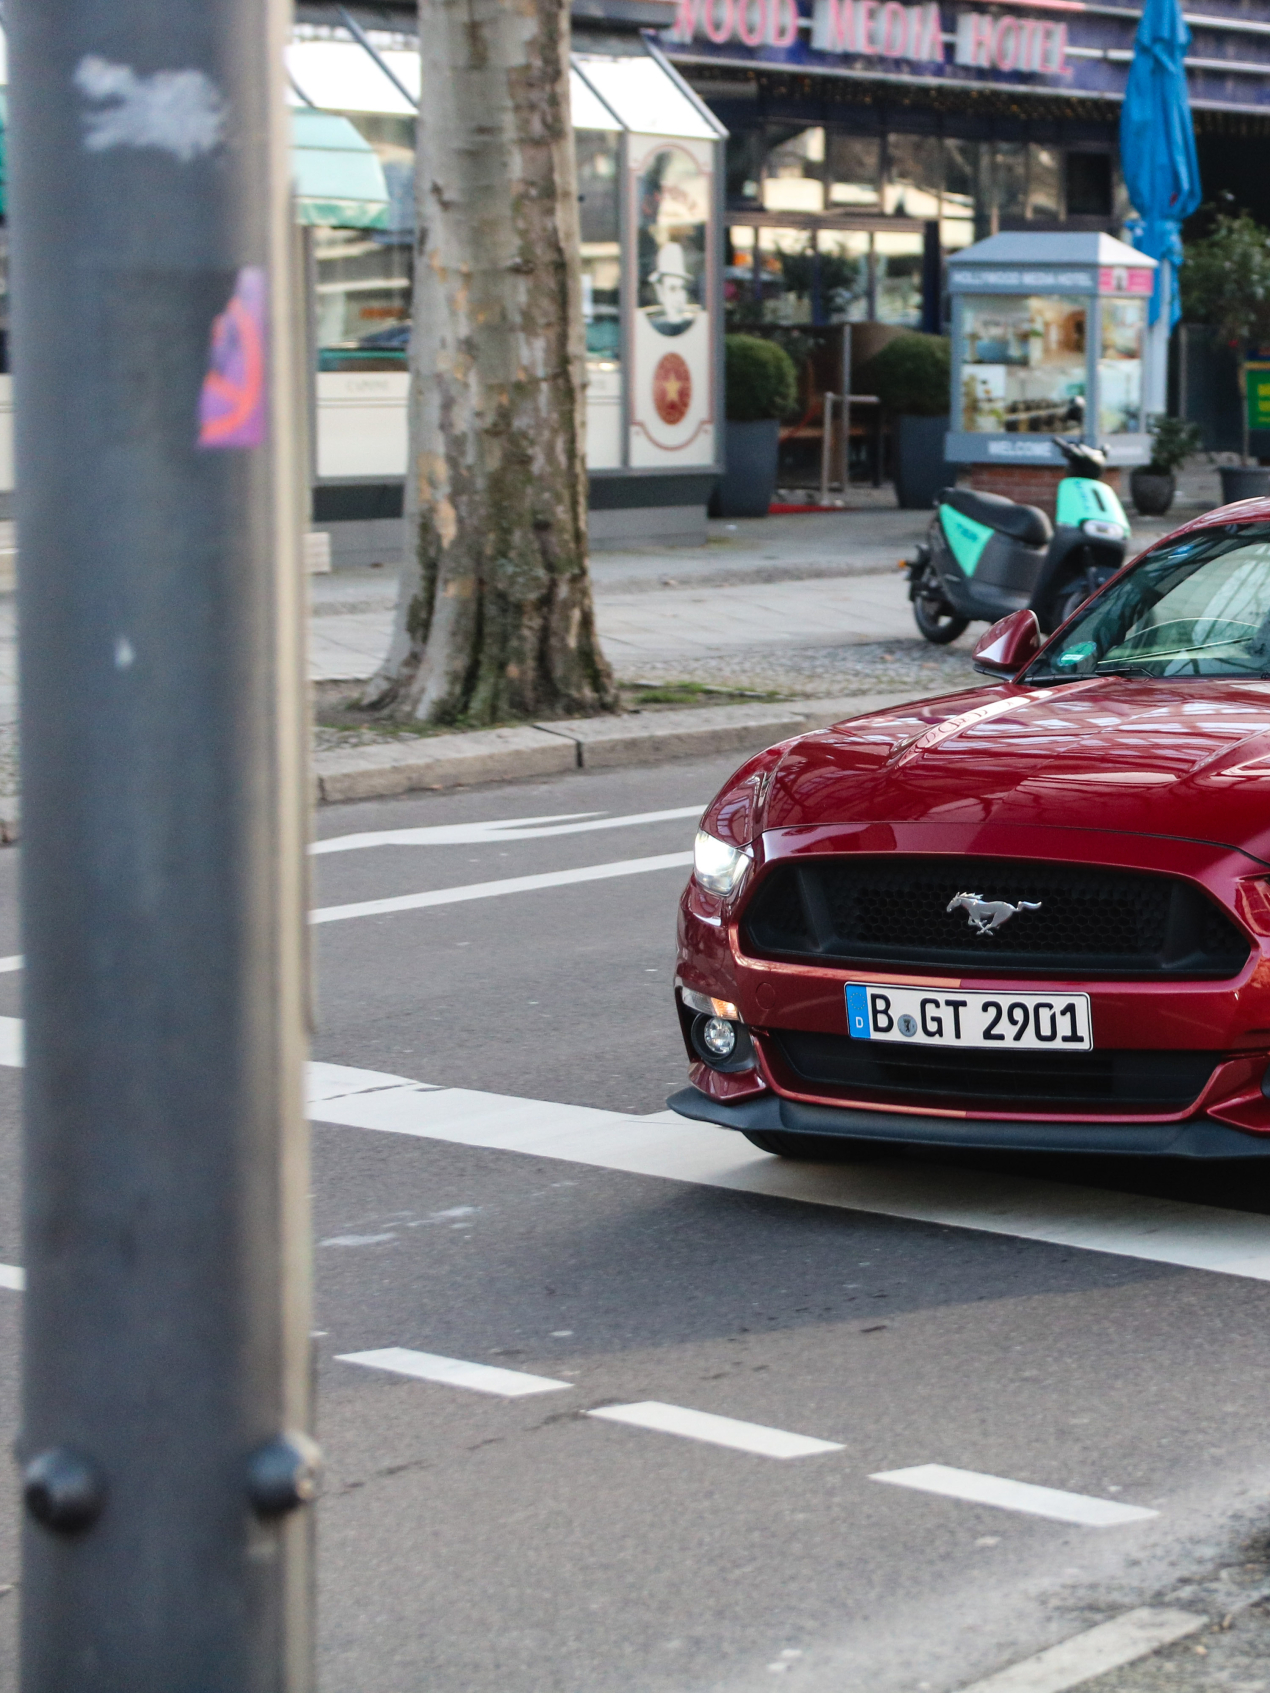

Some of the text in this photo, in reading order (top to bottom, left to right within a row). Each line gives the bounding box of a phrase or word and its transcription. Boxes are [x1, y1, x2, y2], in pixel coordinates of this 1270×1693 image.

[814, 0, 945, 62] MEDIA
[957, 13, 1073, 75] HOTEL
[855, 1017, 864, 1029] D
[870, 993, 1085, 1042] B GT 2901
